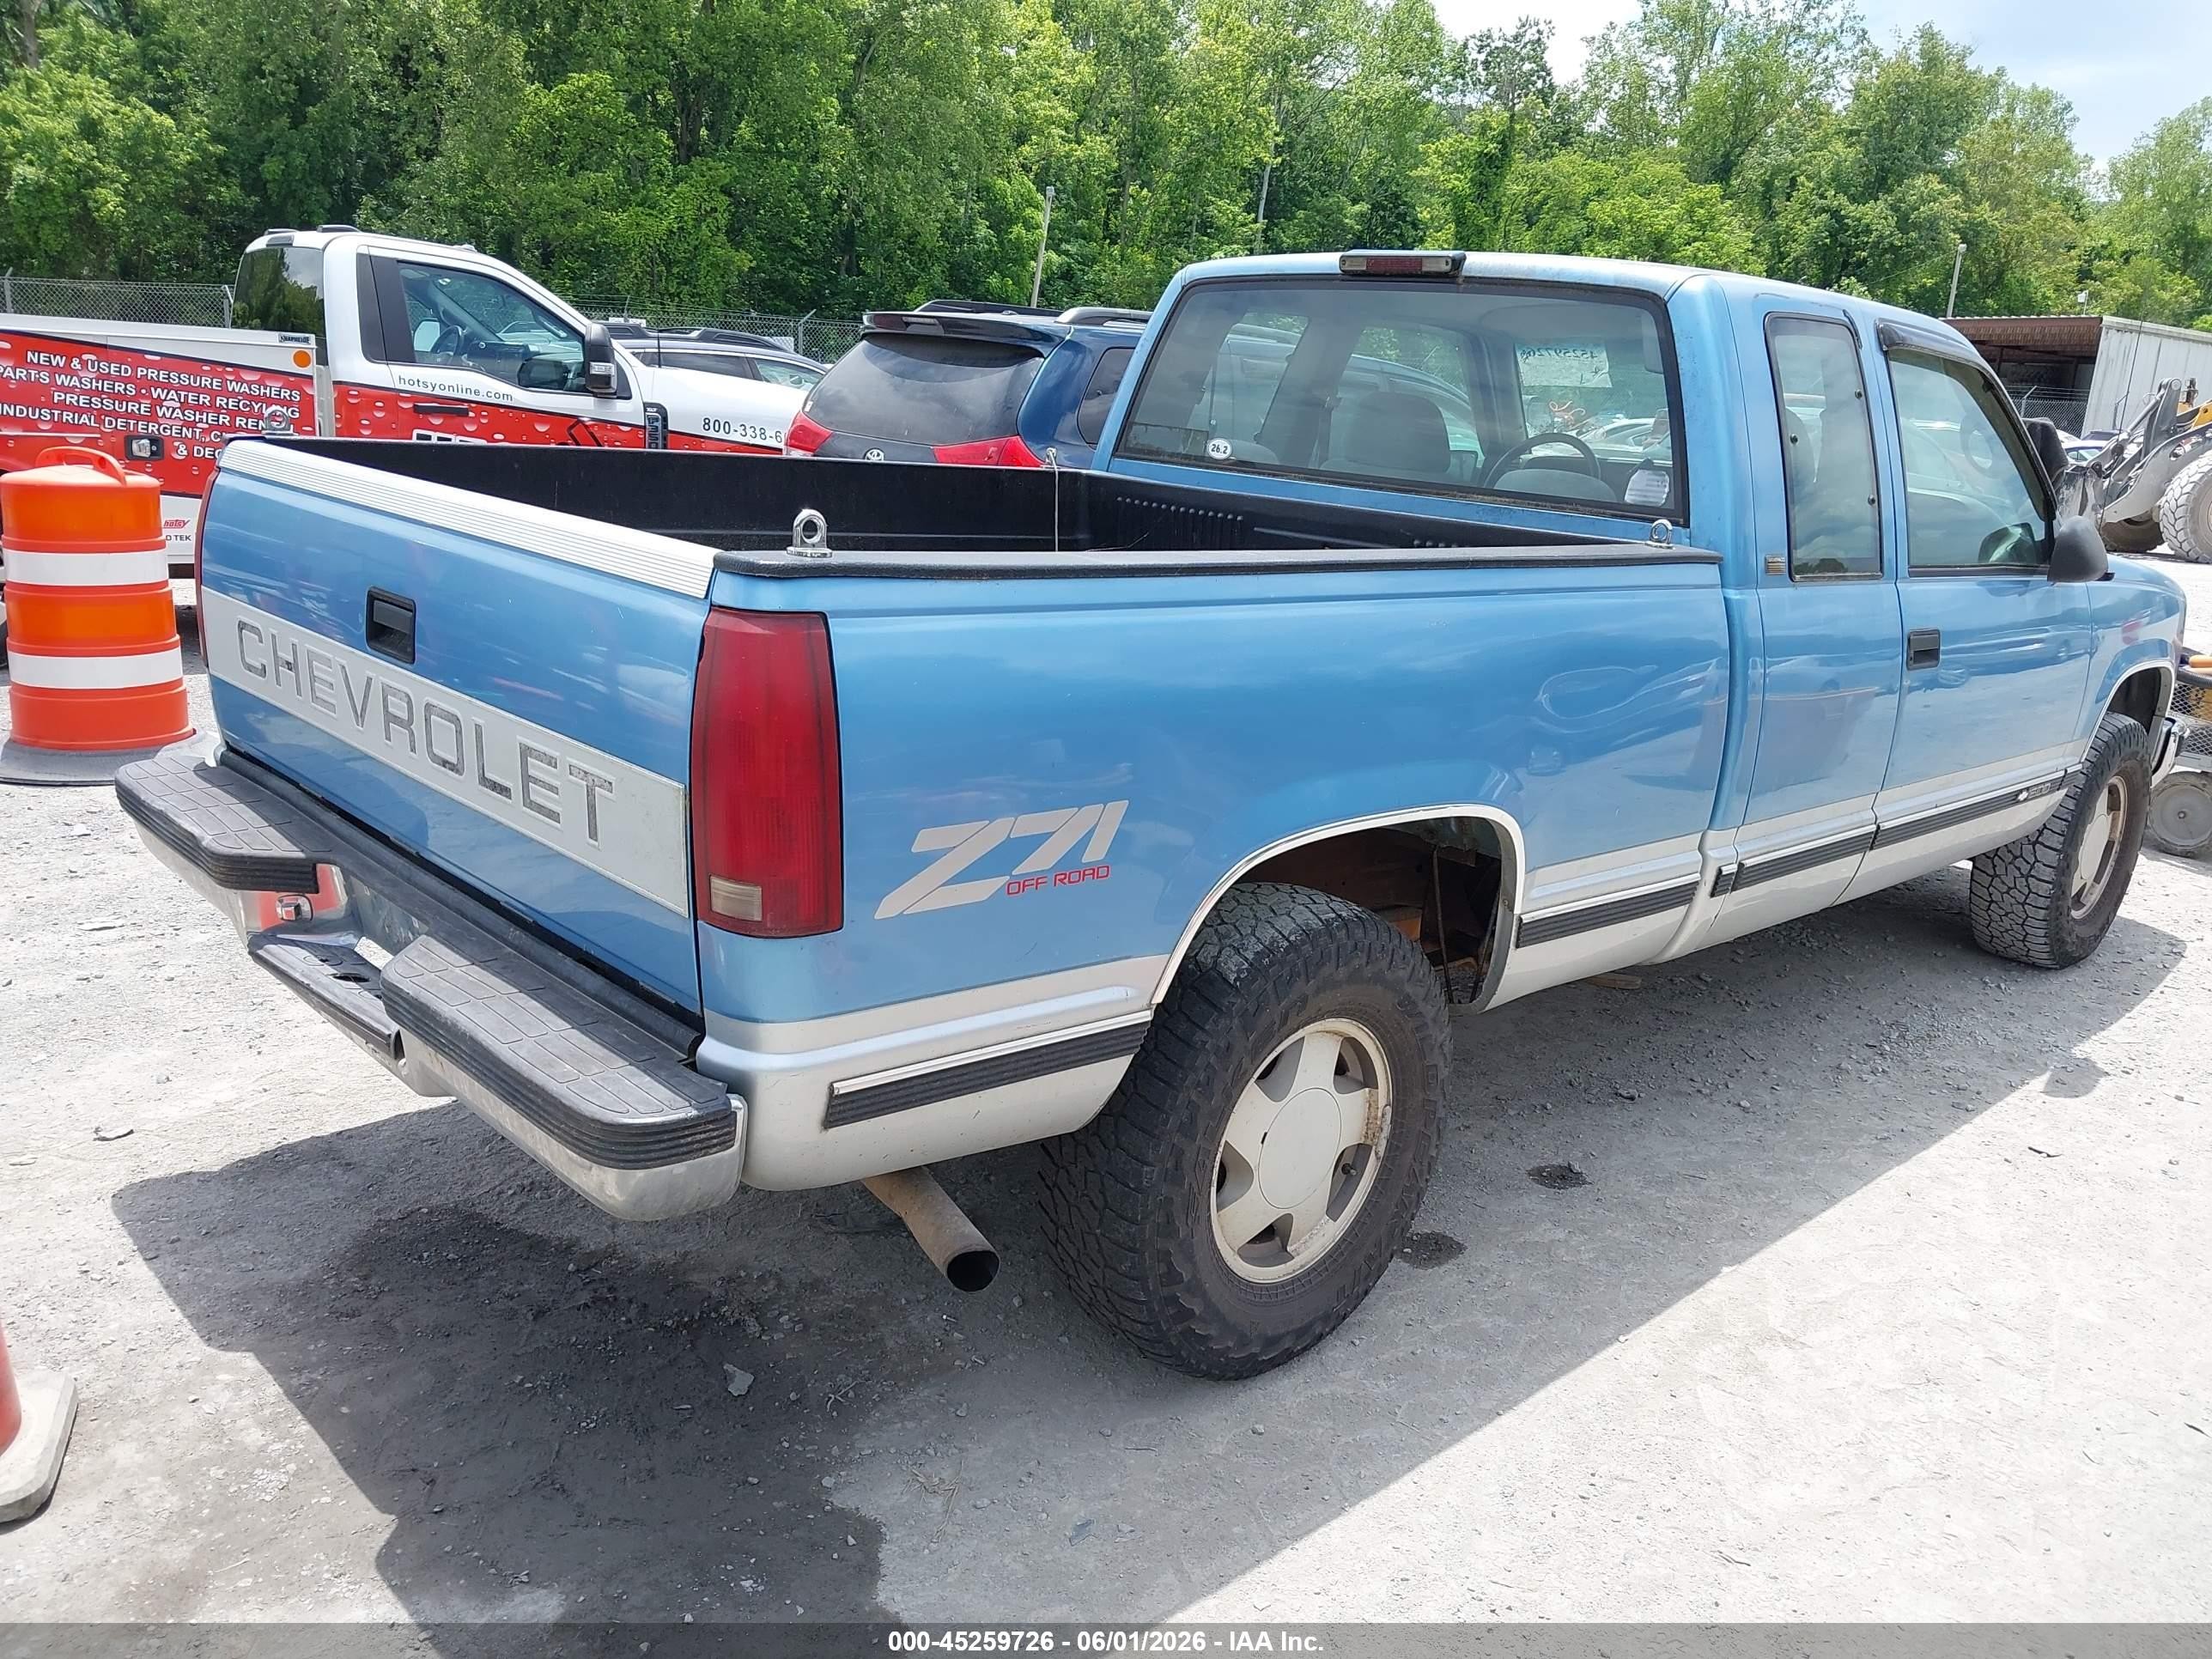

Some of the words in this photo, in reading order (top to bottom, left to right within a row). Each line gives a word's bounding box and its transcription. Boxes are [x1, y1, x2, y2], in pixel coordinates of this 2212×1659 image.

[0, 364, 50, 384] PARTS
[55, 374, 136, 395] WASHERS
[150, 387, 211, 406] WATER
[27, 350, 66, 368] NEW
[70, 357, 82, 370] &
[88, 360, 131, 377] USED
[137, 367, 222, 390] PRESSURE
[227, 380, 301, 402] WASHERS
[398, 375, 514, 401] hotsyonline.com
[0, 402, 100, 428] INDUSTRIAL
[105, 417, 206, 441] DETERGENT,
[53, 392, 151, 416] PRESSURE
[155, 405, 231, 426] WASHER
[702, 417, 783, 443] 800-338-6
[177, 444, 188, 455] &
[1211, 443, 1228, 454] 26.2
[236, 618, 615, 847] CHEVROLET
[874, 799, 1129, 920] Z71
[1006, 876, 1048, 896] OFF
[1053, 865, 1111, 888] ROAD
